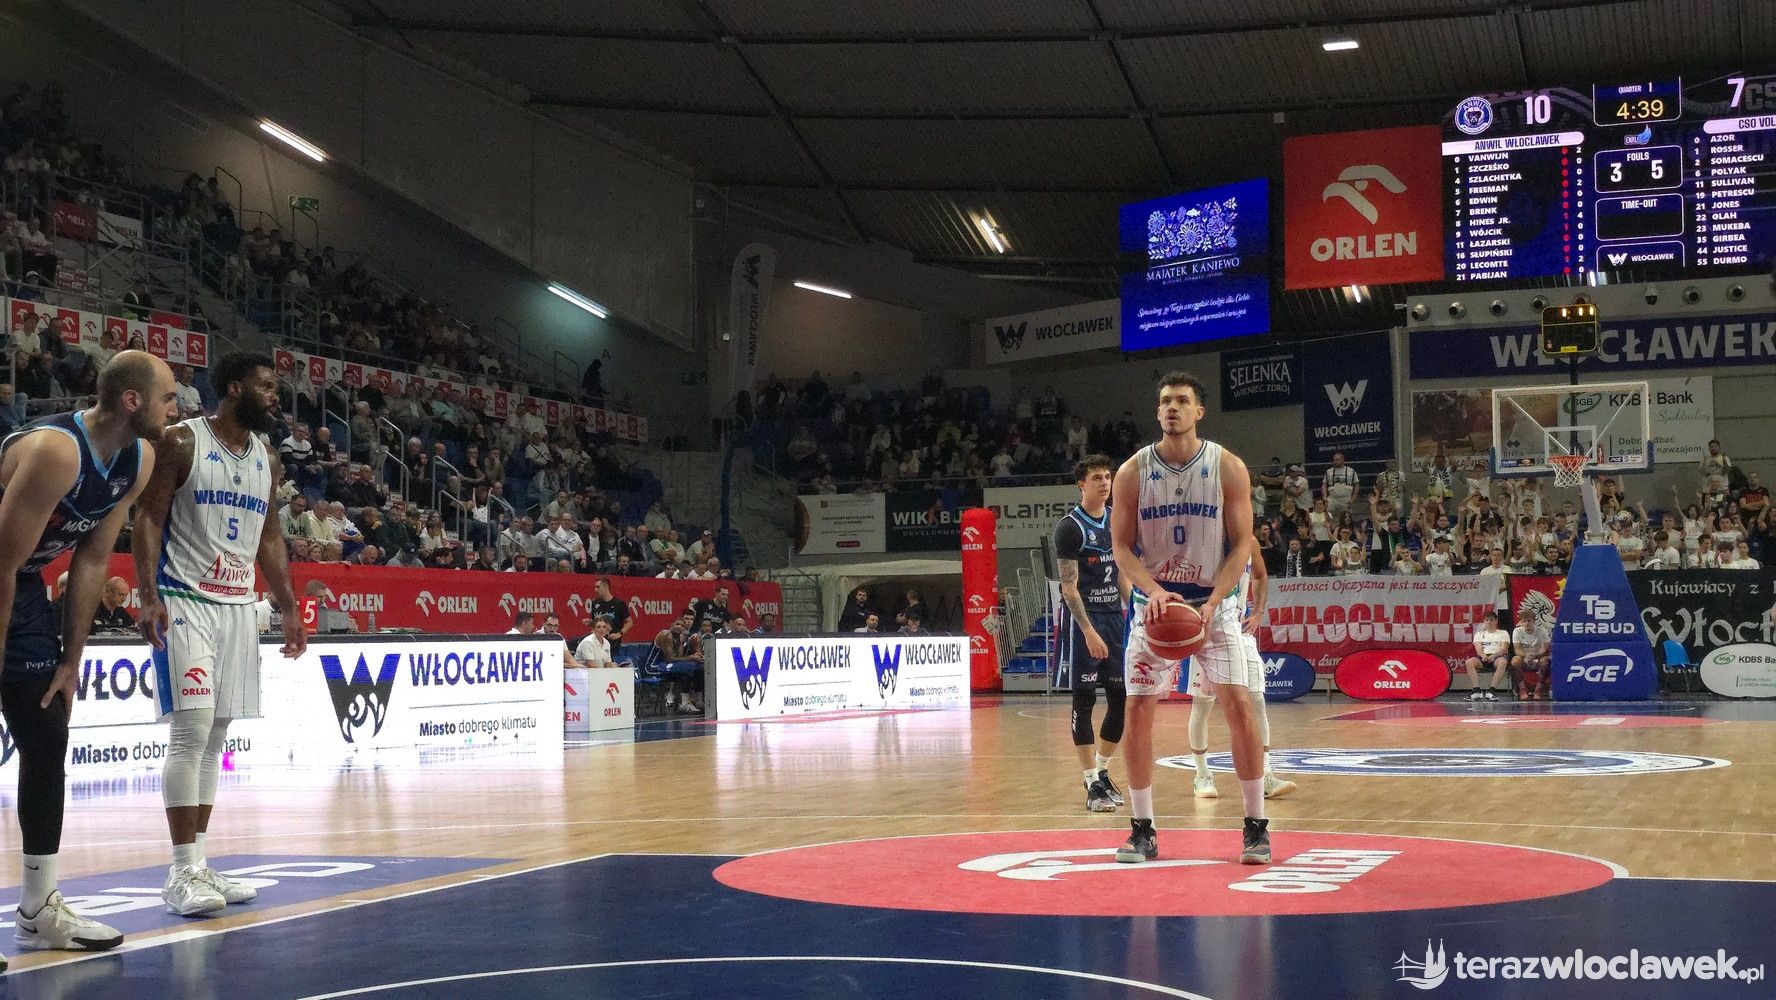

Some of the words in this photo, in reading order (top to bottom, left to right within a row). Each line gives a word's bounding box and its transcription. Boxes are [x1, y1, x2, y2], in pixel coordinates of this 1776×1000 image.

[1618, 85, 1642, 94] QUARTER
[1648, 82, 1653, 92] 1
[1727, 78, 1745, 108] 7
[1524, 95, 1551, 125] 10
[1616, 99, 1664, 120] 4:39
[1738, 118, 1757, 129] CSO
[1474, 139, 1502, 151] ANWIL
[1505, 134, 1560, 148] WŁOCŁAWEK
[1710, 134, 1735, 143] AZOR
[1711, 144, 1743, 154] ROSSER
[1468, 152, 1508, 162] VANWIJN
[1627, 152, 1650, 161] FOULS
[1711, 154, 1764, 165] SOMACESCU
[1468, 163, 1510, 173] SZCZEŚKO
[1610, 163, 1622, 182] 3
[1651, 159, 1663, 179] 5
[1711, 167, 1746, 176] POLYAK
[1468, 173, 1522, 184] SZLACHETKA
[1711, 177, 1755, 187] SULLIVAN
[1469, 185, 1508, 195] FREEMAN
[1711, 189, 1755, 198] PETRESCU
[1469, 196, 1498, 205] EDWIN
[1621, 199, 1658, 209] TIME-OUT
[1711, 201, 1740, 209] JONES
[1469, 207, 1497, 216] BRENK
[1712, 212, 1737, 220] OLAH
[1470, 218, 1494, 227] HINES
[1712, 222, 1751, 231] MUKEBA
[1470, 228, 1502, 237] WÓJCIK
[1712, 234, 1745, 242] GIRBEA
[1310, 232, 1418, 262] ORLEN
[1470, 238, 1510, 248] ŁAZARSKI
[1470, 248, 1512, 259] SŁUPIŃSKI
[1713, 245, 1748, 254] JUSTICE
[1631, 253, 1674, 262] WŁOCŁAWEK
[1713, 256, 1747, 265] DURMO
[1192, 257, 1240, 274] KANIEWO
[1470, 260, 1508, 269] LECOMTE
[1470, 271, 1507, 280] PABIJAN
[1035, 316, 1113, 340] WŁOCŁAWEK
[1489, 321, 1776, 368] WŁCŁAWEK
[1230, 362, 1292, 390] SELENKA
[1657, 390, 1694, 404] Bank
[1314, 421, 1381, 438] WŁOCŁAWEK
[1656, 446, 1702, 456] nawzajem
[193, 490, 268, 516] WŁOCŁAWEK
[1140, 502, 1218, 520] WŁOCŁAWEK
[226, 518, 239, 540] 5
[1174, 525, 1186, 544] 0
[1103, 566, 1112, 584] 2
[1156, 560, 1202, 581] Anwil
[200, 583, 229, 594] GRUPA
[1279, 581, 1329, 592] wartości
[1332, 580, 1385, 594] Ojczyzna
[1389, 580, 1409, 594] jest
[1412, 582, 1427, 590] na
[1431, 579, 1480, 594] szczycie
[1650, 580, 1736, 597] Kujawiacy
[1750, 583, 1759, 594] z
[339, 594, 384, 612] ORLEN
[438, 596, 478, 614] ORLEN
[518, 598, 554, 613] ORLEN
[644, 600, 672, 615] ORLEN
[754, 602, 778, 615] ORLEN
[303, 601, 315, 624] 5
[1268, 603, 1495, 644] WŁOCŁAWEK
[1560, 622, 1635, 634] TERBUD
[778, 646, 851, 671] WŁOCŁAWEK
[905, 643, 962, 665] WŁOCŁAWEK
[409, 651, 544, 687] WŁOCŁAWEK
[1566, 665, 1620, 682] PGE
[1130, 677, 1155, 685] ORLEN
[1264, 680, 1294, 688] CŁAWEK
[1373, 681, 1410, 689] ORLEN
[182, 687, 211, 696] ORLEN
[909, 687, 925, 696] Miasto
[784, 696, 804, 707] Miasto
[604, 707, 621, 717] ORLEN
[420, 721, 456, 736] Miasto
[459, 719, 499, 734] dobrego
[502, 715, 536, 730] klimatu
[72, 744, 128, 765] Miasto
[132, 742, 168, 760] dobr
[1227, 848, 1404, 893] ORLEN
